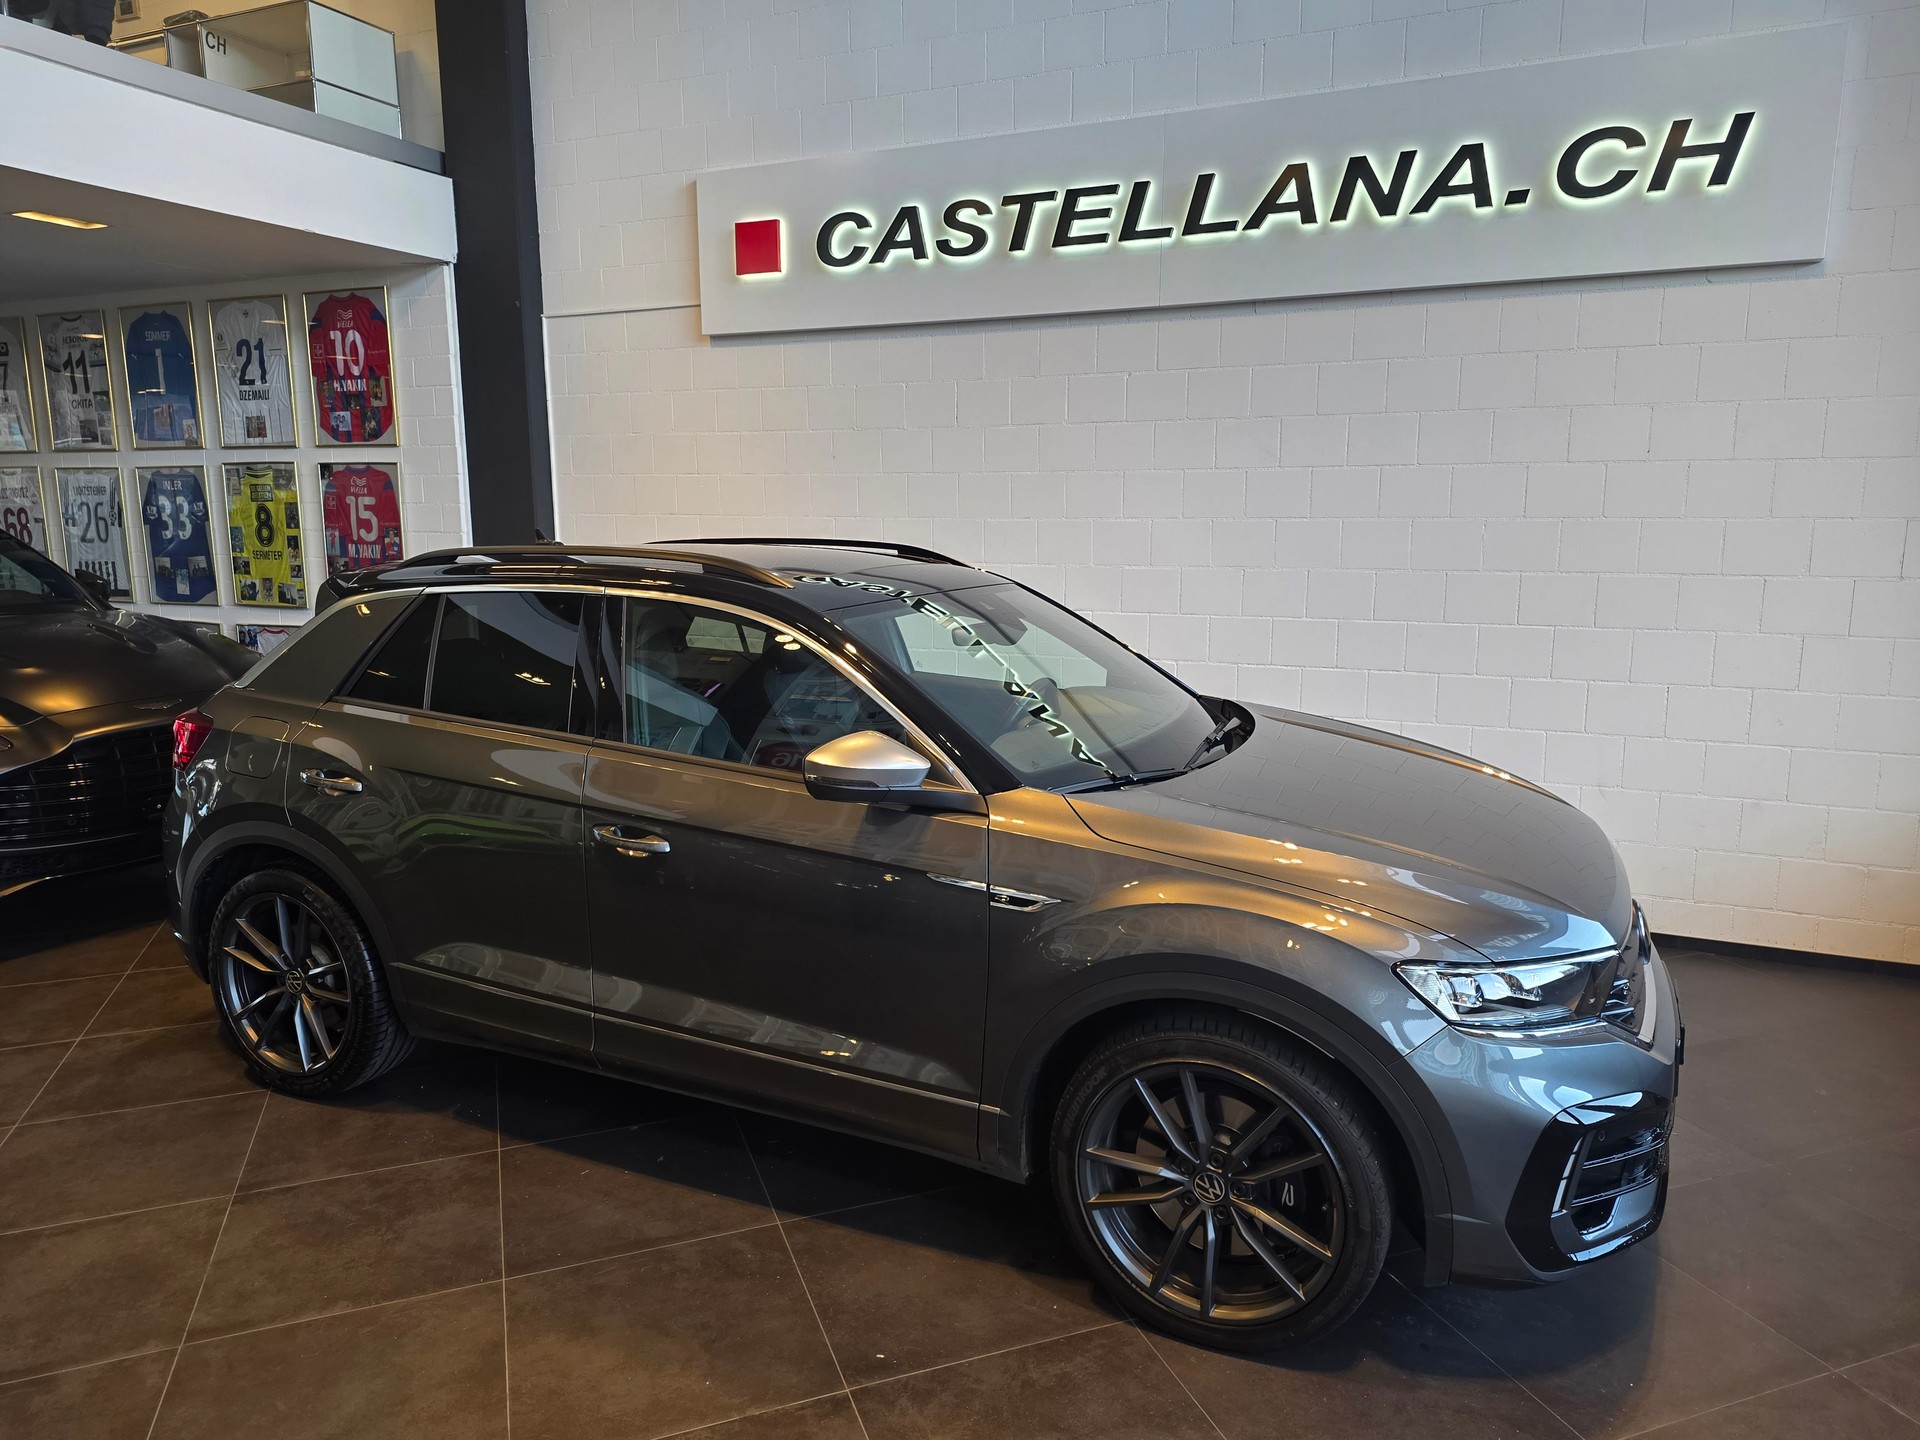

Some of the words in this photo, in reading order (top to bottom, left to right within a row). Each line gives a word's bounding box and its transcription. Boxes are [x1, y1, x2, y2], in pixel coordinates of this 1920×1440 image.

[205, 31, 227, 56] CH
[815, 111, 1756, 268] CASTELLANA.CH
[145, 330, 171, 342] SOMMER
[329, 329, 365, 377] 10
[62, 350, 90, 395] 11
[155, 348, 166, 395] 1
[236, 337, 268, 386] 21
[71, 398, 94, 411] OKITA
[239, 389, 270, 401] DZEMAILI
[162, 480, 183, 491] INLER
[3, 506, 33, 546] 68
[78, 501, 109, 544] 26
[158, 495, 193, 540] 33
[254, 503, 276, 548] 8
[345, 495, 379, 542] 15
[348, 543, 382, 559] M.YAKIN
